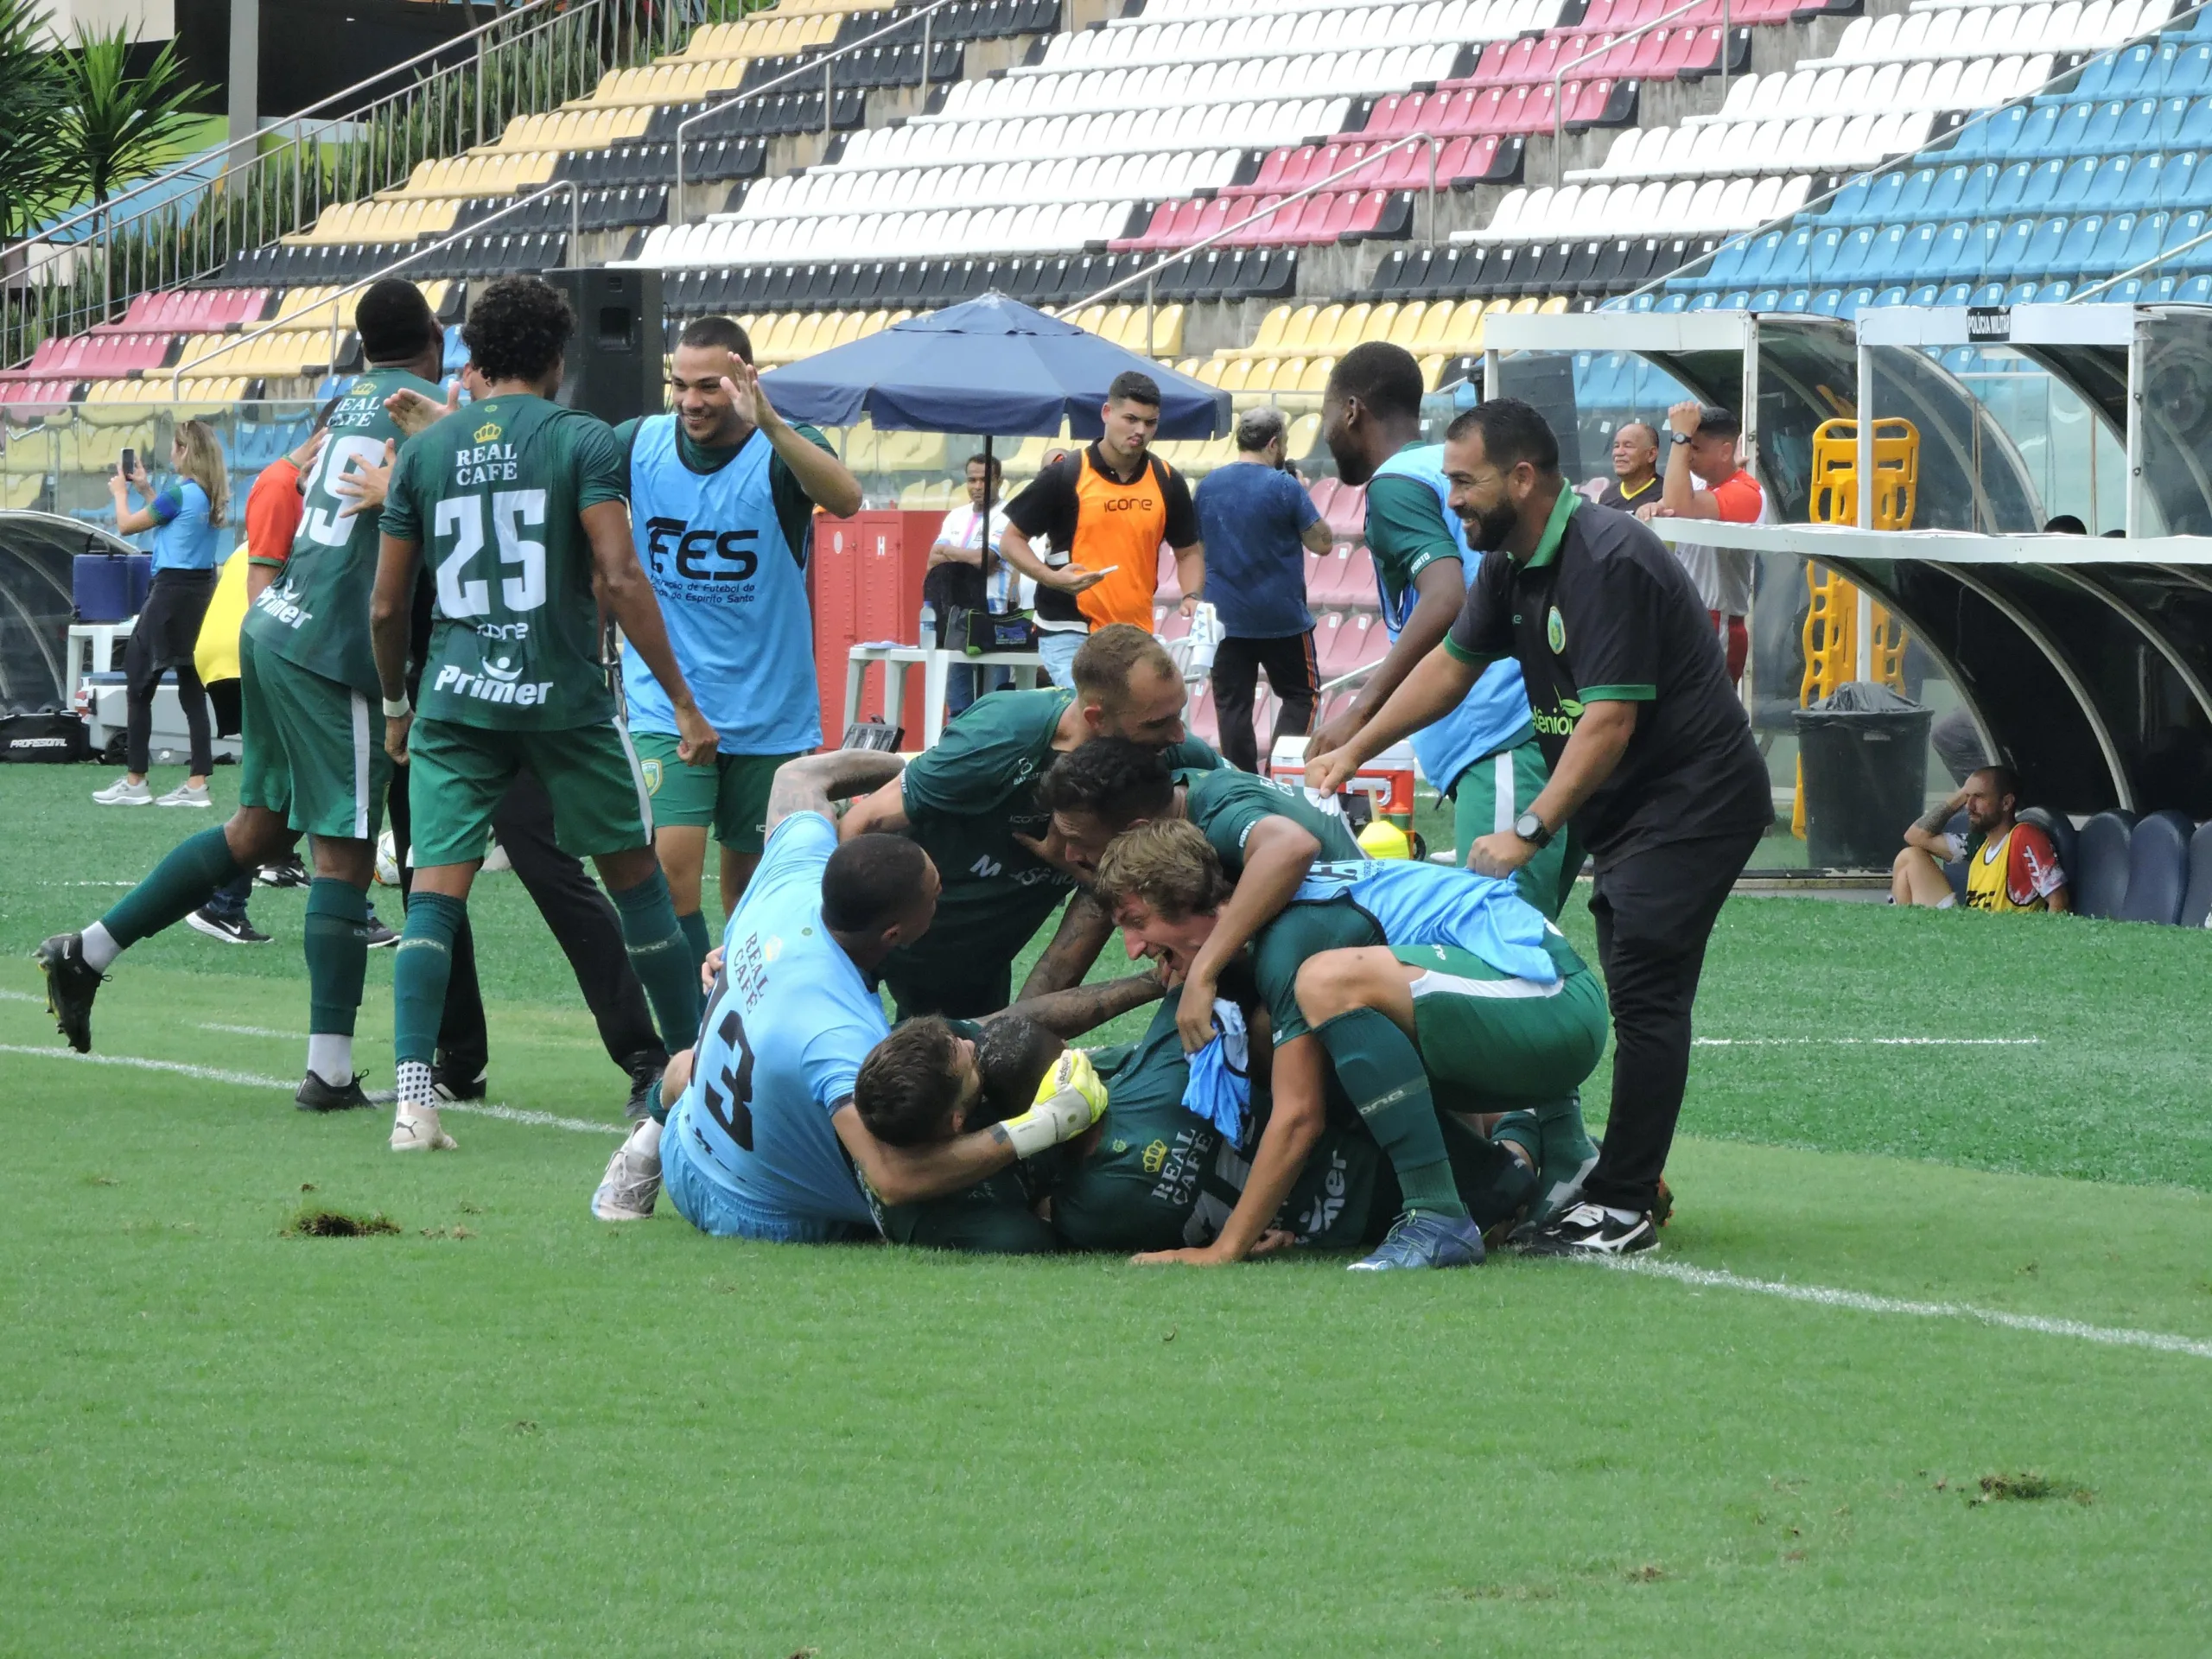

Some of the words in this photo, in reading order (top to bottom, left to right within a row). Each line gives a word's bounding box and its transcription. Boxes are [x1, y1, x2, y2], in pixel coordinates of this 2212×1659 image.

[1967, 312, 1992, 334] POLÍCIA
[456, 443, 518, 467] REAL
[456, 461, 518, 486] CAFÉ
[435, 489, 546, 619] 25
[1410, 551, 1431, 574] PORTO
[703, 583, 740, 593] Futebol
[743, 583, 755, 592] do
[727, 594, 755, 603] Santo
[434, 664, 554, 705] Primer
[745, 931, 770, 998] REAL
[734, 948, 759, 1014] CAFÉ
[1151, 1128, 1196, 1201] REAL
